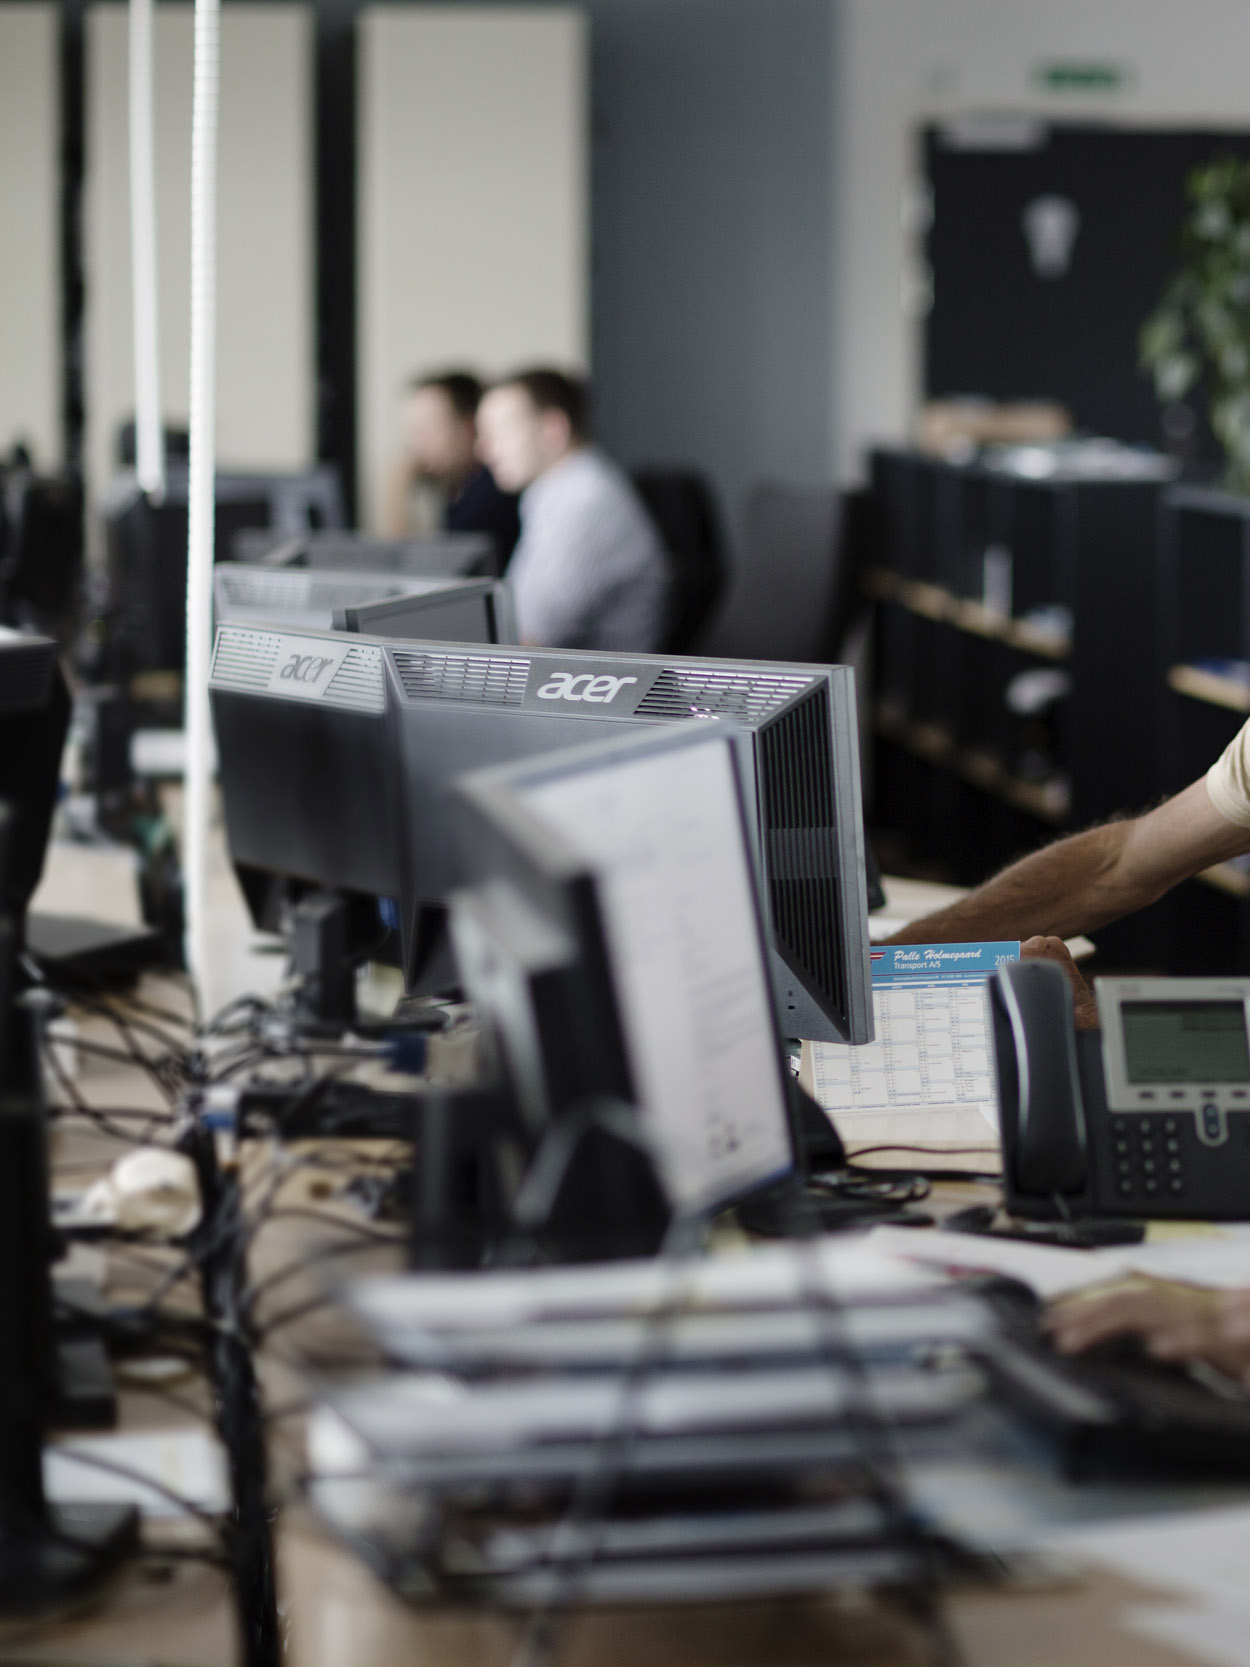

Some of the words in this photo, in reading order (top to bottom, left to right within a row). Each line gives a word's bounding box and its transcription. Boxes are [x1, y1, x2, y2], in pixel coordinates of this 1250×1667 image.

[279, 653, 334, 683] acer
[536, 672, 638, 704] acer
[894, 950, 920, 961] Palle
[924, 949, 982, 961] Holmegaard
[994, 954, 1015, 966] 2015
[894, 962, 927, 970] Transport
